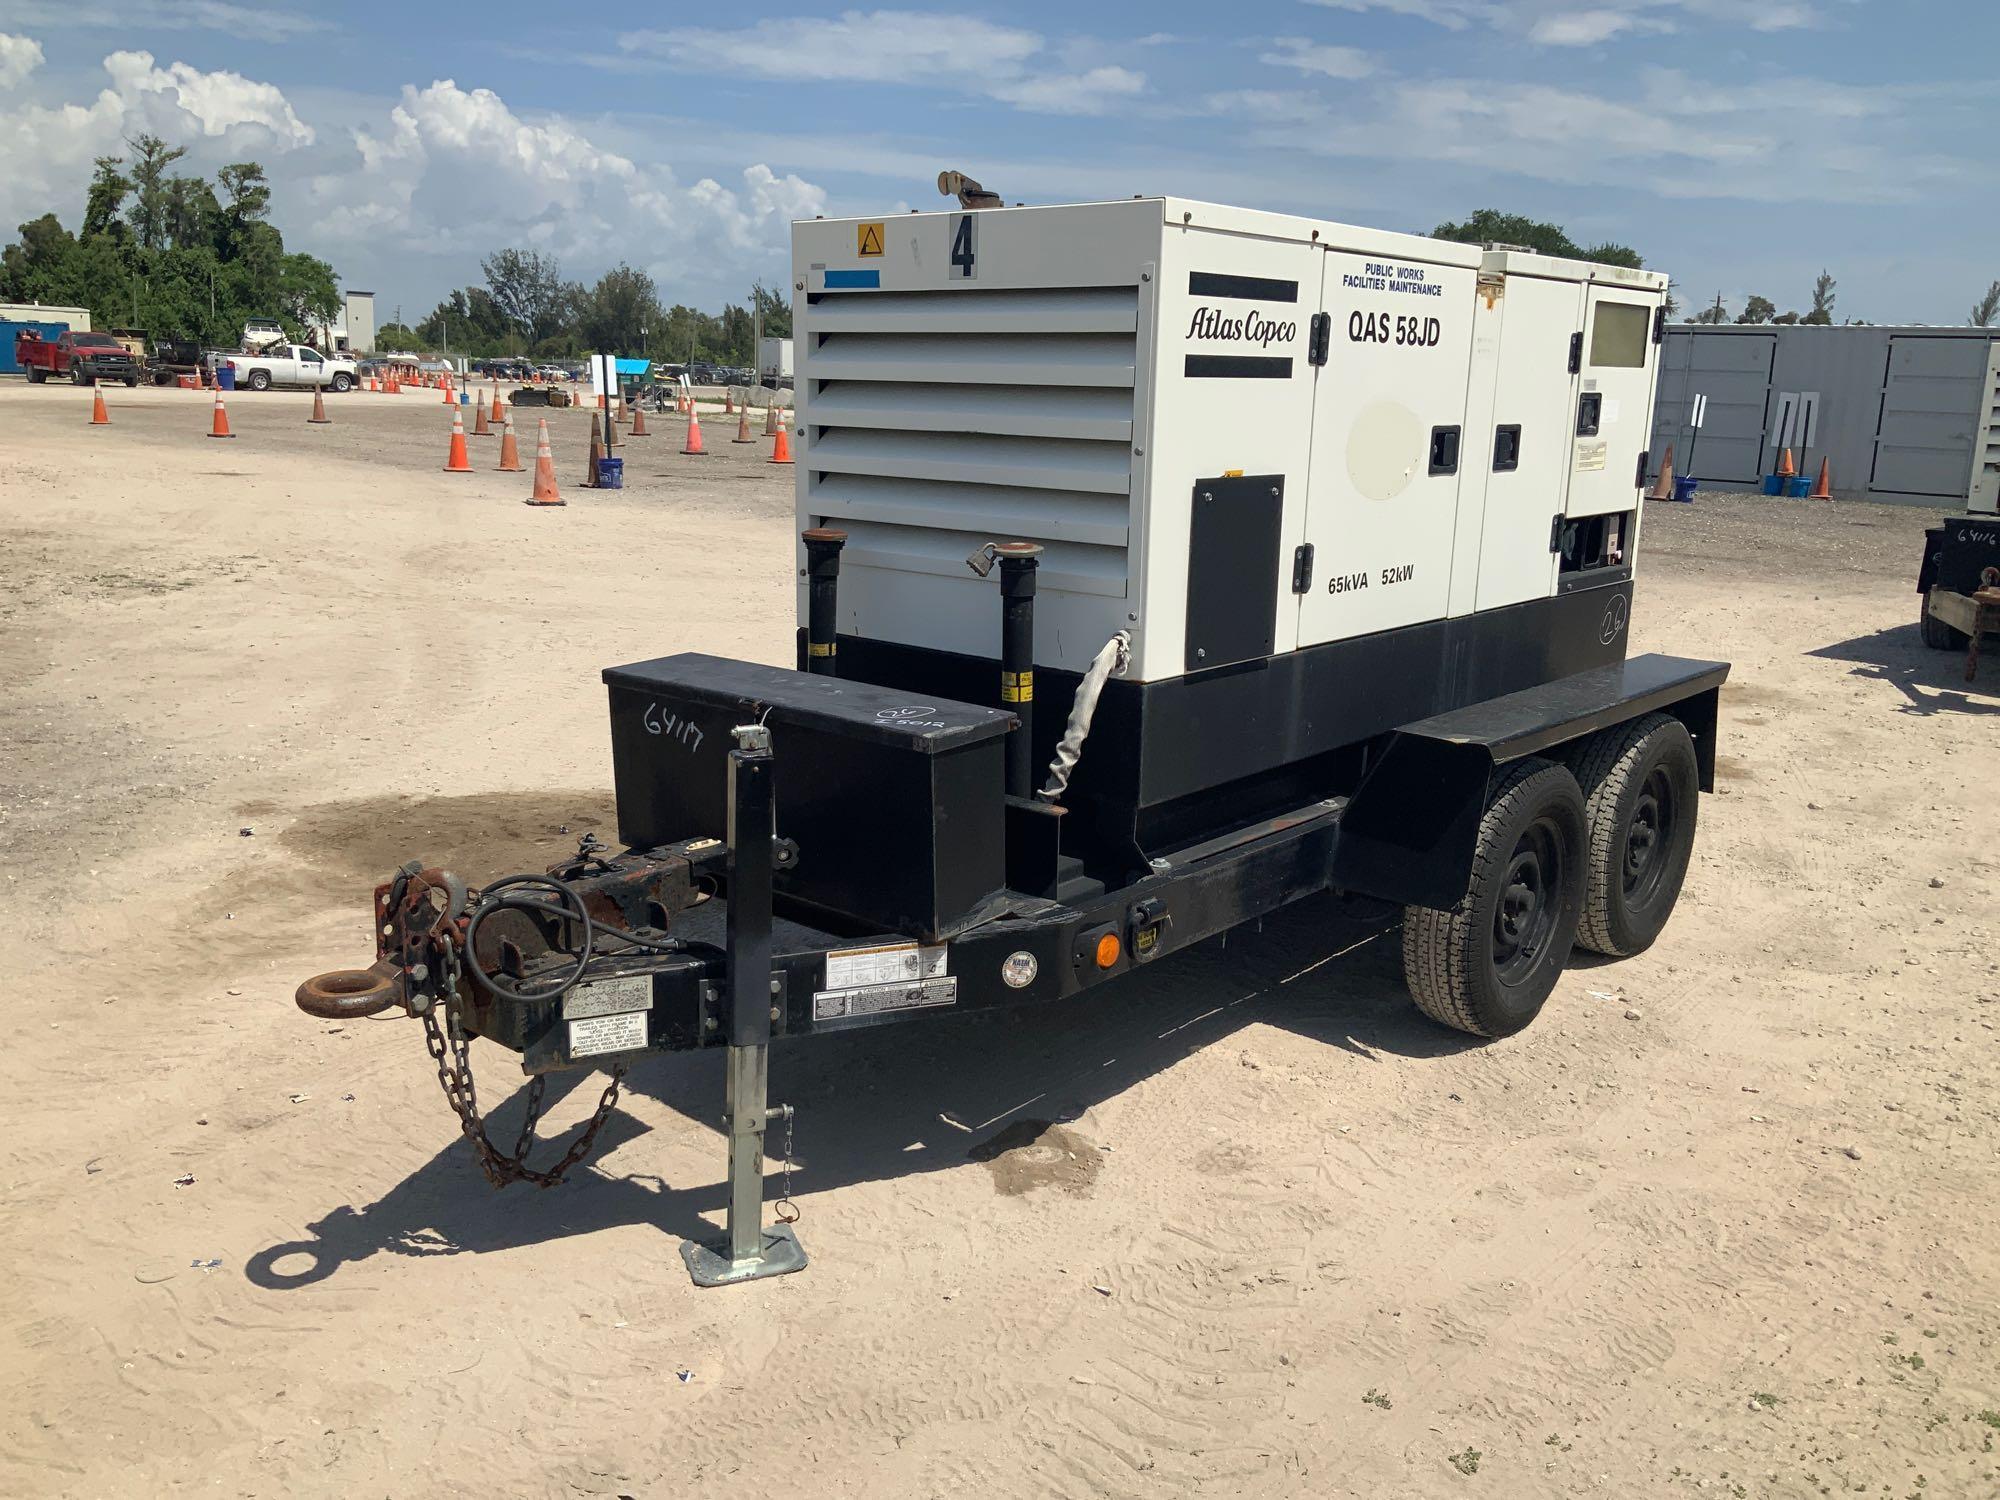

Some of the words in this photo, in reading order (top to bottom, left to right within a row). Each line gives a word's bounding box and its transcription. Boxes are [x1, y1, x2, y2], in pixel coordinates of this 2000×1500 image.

[952, 215, 974, 276] 4
[1343, 275, 1385, 290] FACILITIES
[1389, 280, 1441, 296] MAINTENANCE
[1365, 263, 1393, 277] PUBLIC
[1397, 267, 1424, 281] WORKS
[1185, 307, 1243, 341] Atlas
[1245, 310, 1296, 348] Copco
[1349, 311, 1390, 343] QAS
[1396, 316, 1440, 347] 58JD
[1958, 529, 1995, 545] 64116
[1328, 572, 1368, 594] 65kVA
[1382, 564, 1414, 585] 52kW
